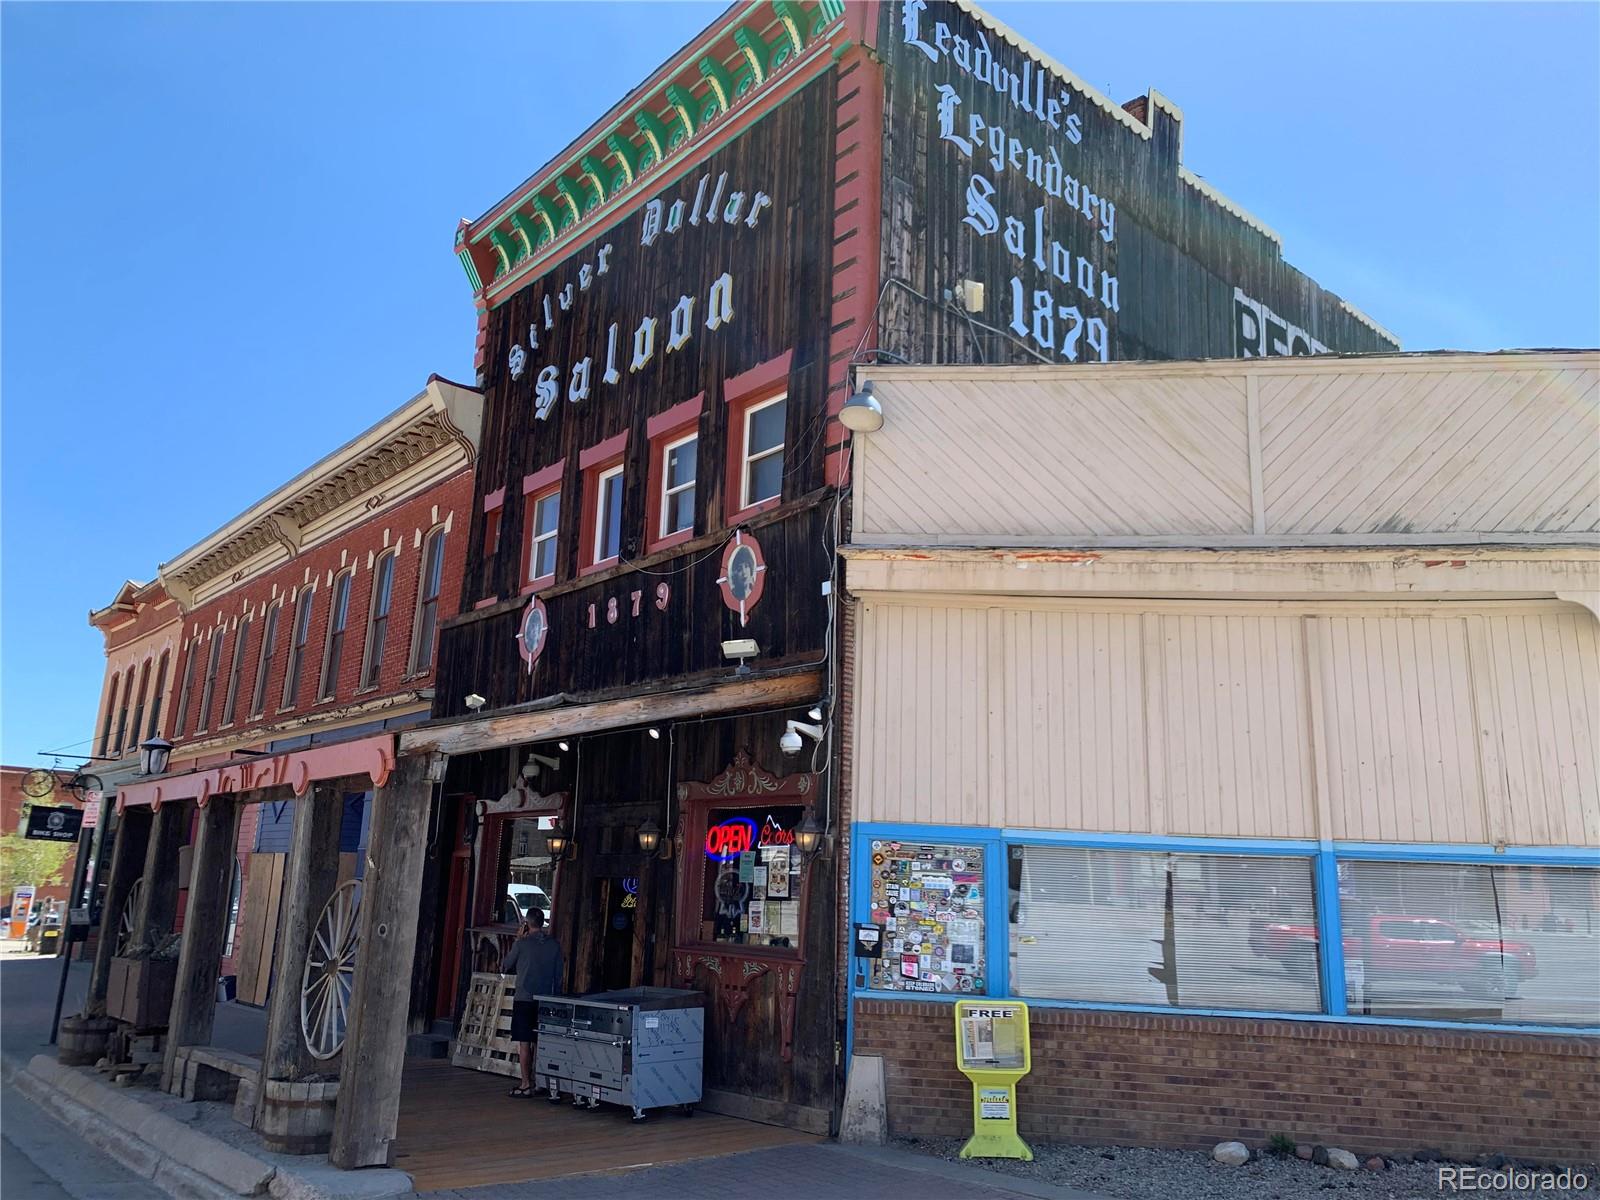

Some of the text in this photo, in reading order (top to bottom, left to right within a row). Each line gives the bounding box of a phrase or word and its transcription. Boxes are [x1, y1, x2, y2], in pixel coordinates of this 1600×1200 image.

[934, 83, 1116, 243] Legendary
[508, 170, 772, 381] Silver Dollar
[961, 173, 1120, 313] Saloon
[534, 272, 735, 421] Saloon
[1009, 276, 1108, 363] 1879
[588, 582, 669, 629] 1879
[706, 824, 752, 854] OPEN
[968, 1009, 1013, 1018] FREE
